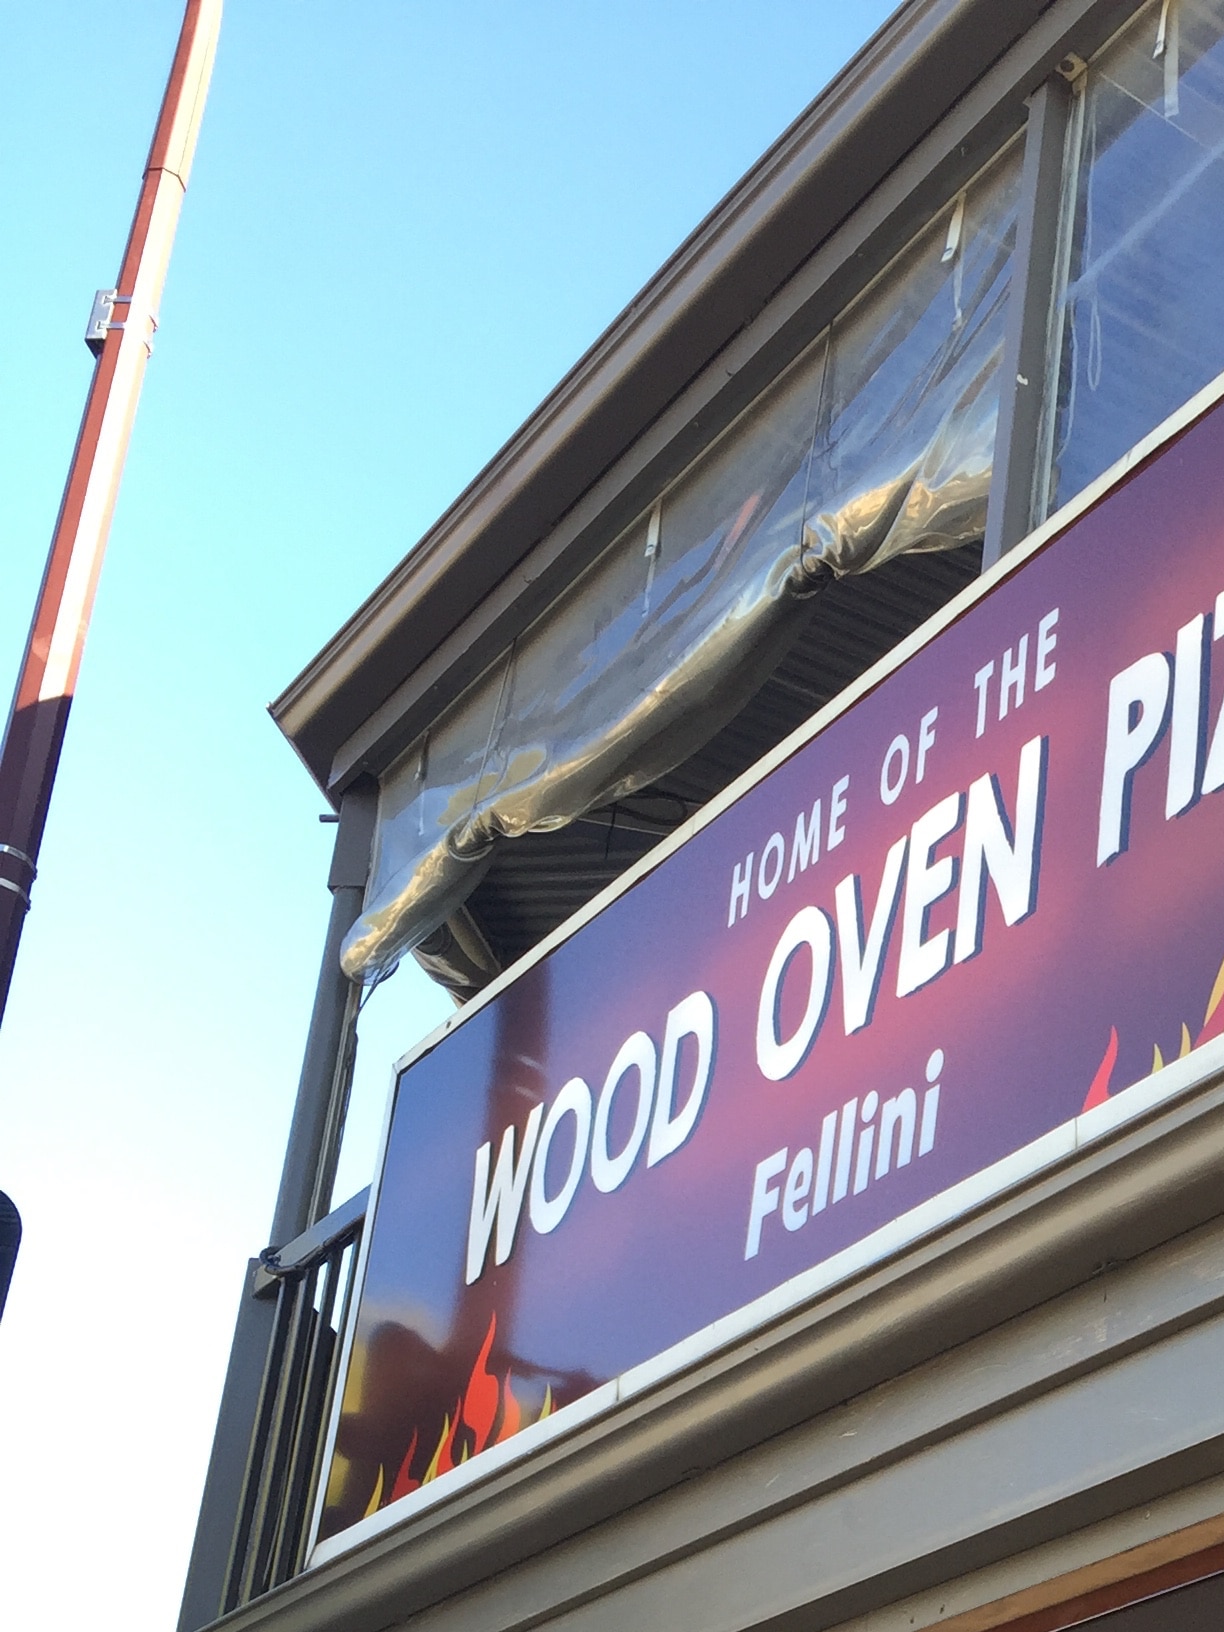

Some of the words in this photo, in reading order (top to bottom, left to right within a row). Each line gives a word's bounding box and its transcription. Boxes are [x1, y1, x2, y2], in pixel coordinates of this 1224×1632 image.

[728, 774, 851, 927] HOME
[880, 706, 939, 806] OF
[973, 607, 1060, 738] THE
[466, 990, 716, 1285] WOOD
[756, 735, 1049, 1081] OVEN
[744, 1048, 944, 1261] Fellini
